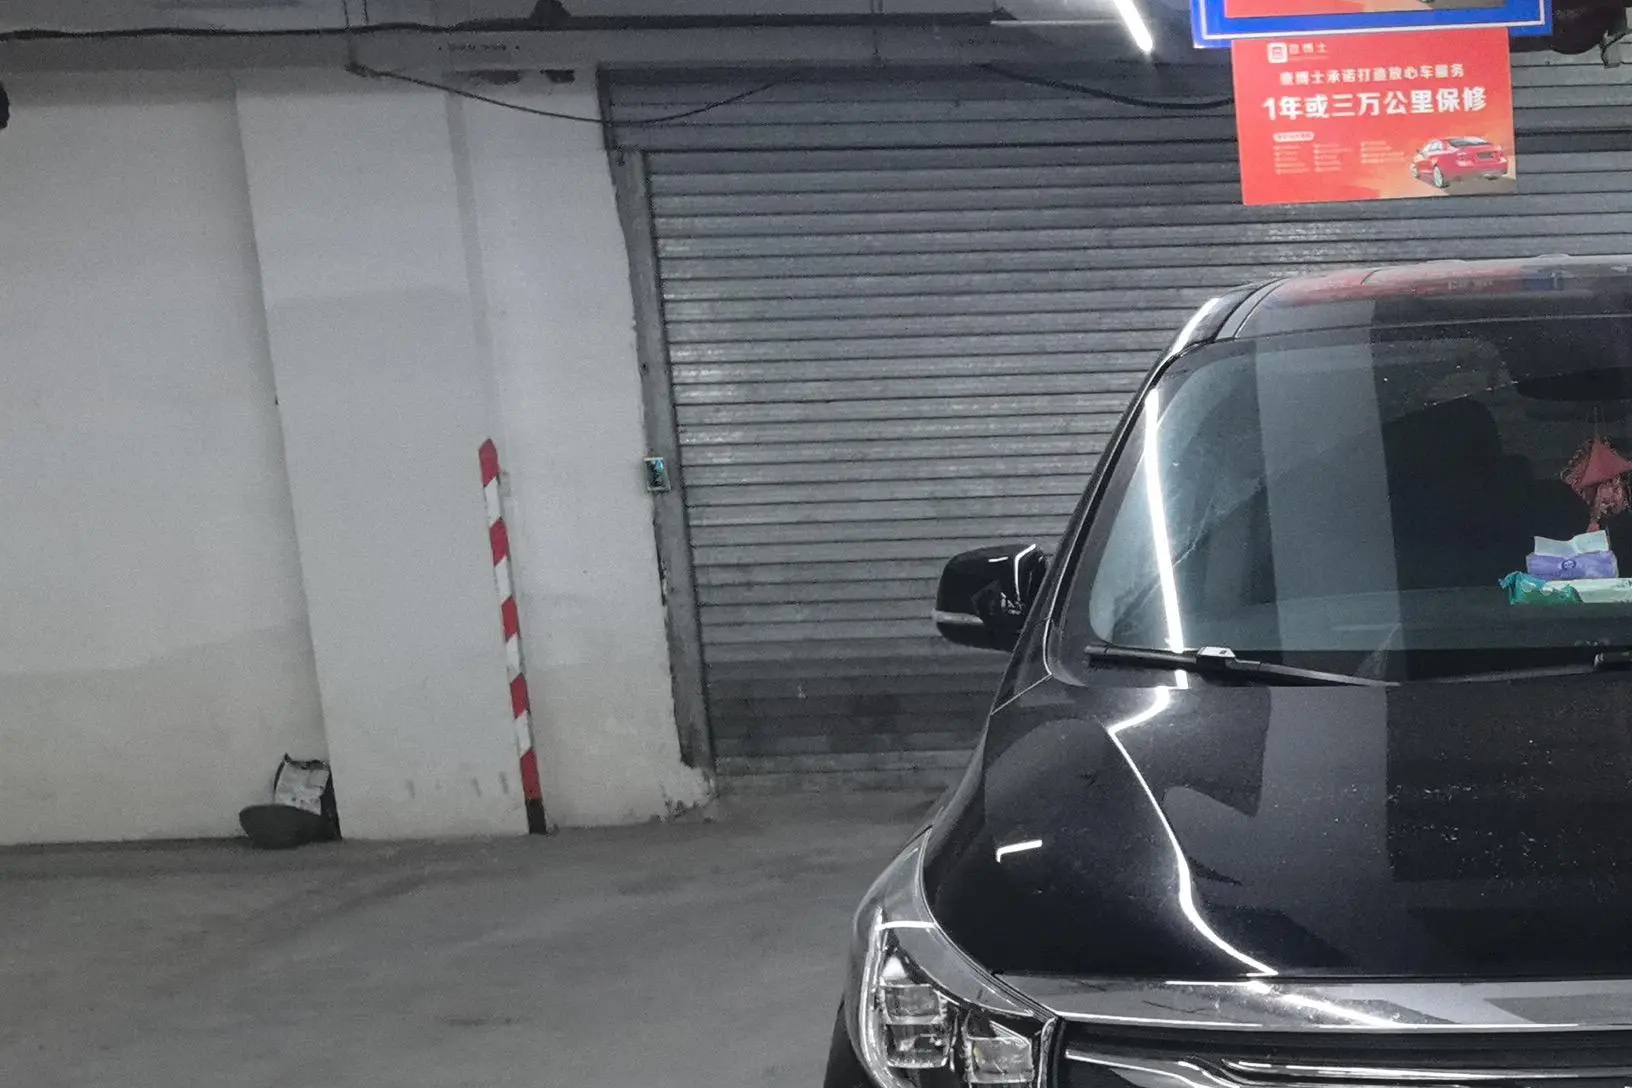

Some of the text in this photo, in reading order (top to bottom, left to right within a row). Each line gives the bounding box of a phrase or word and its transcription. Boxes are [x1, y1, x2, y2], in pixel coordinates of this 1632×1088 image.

[1262, 86, 1487, 120] 1年或三万公里保修
